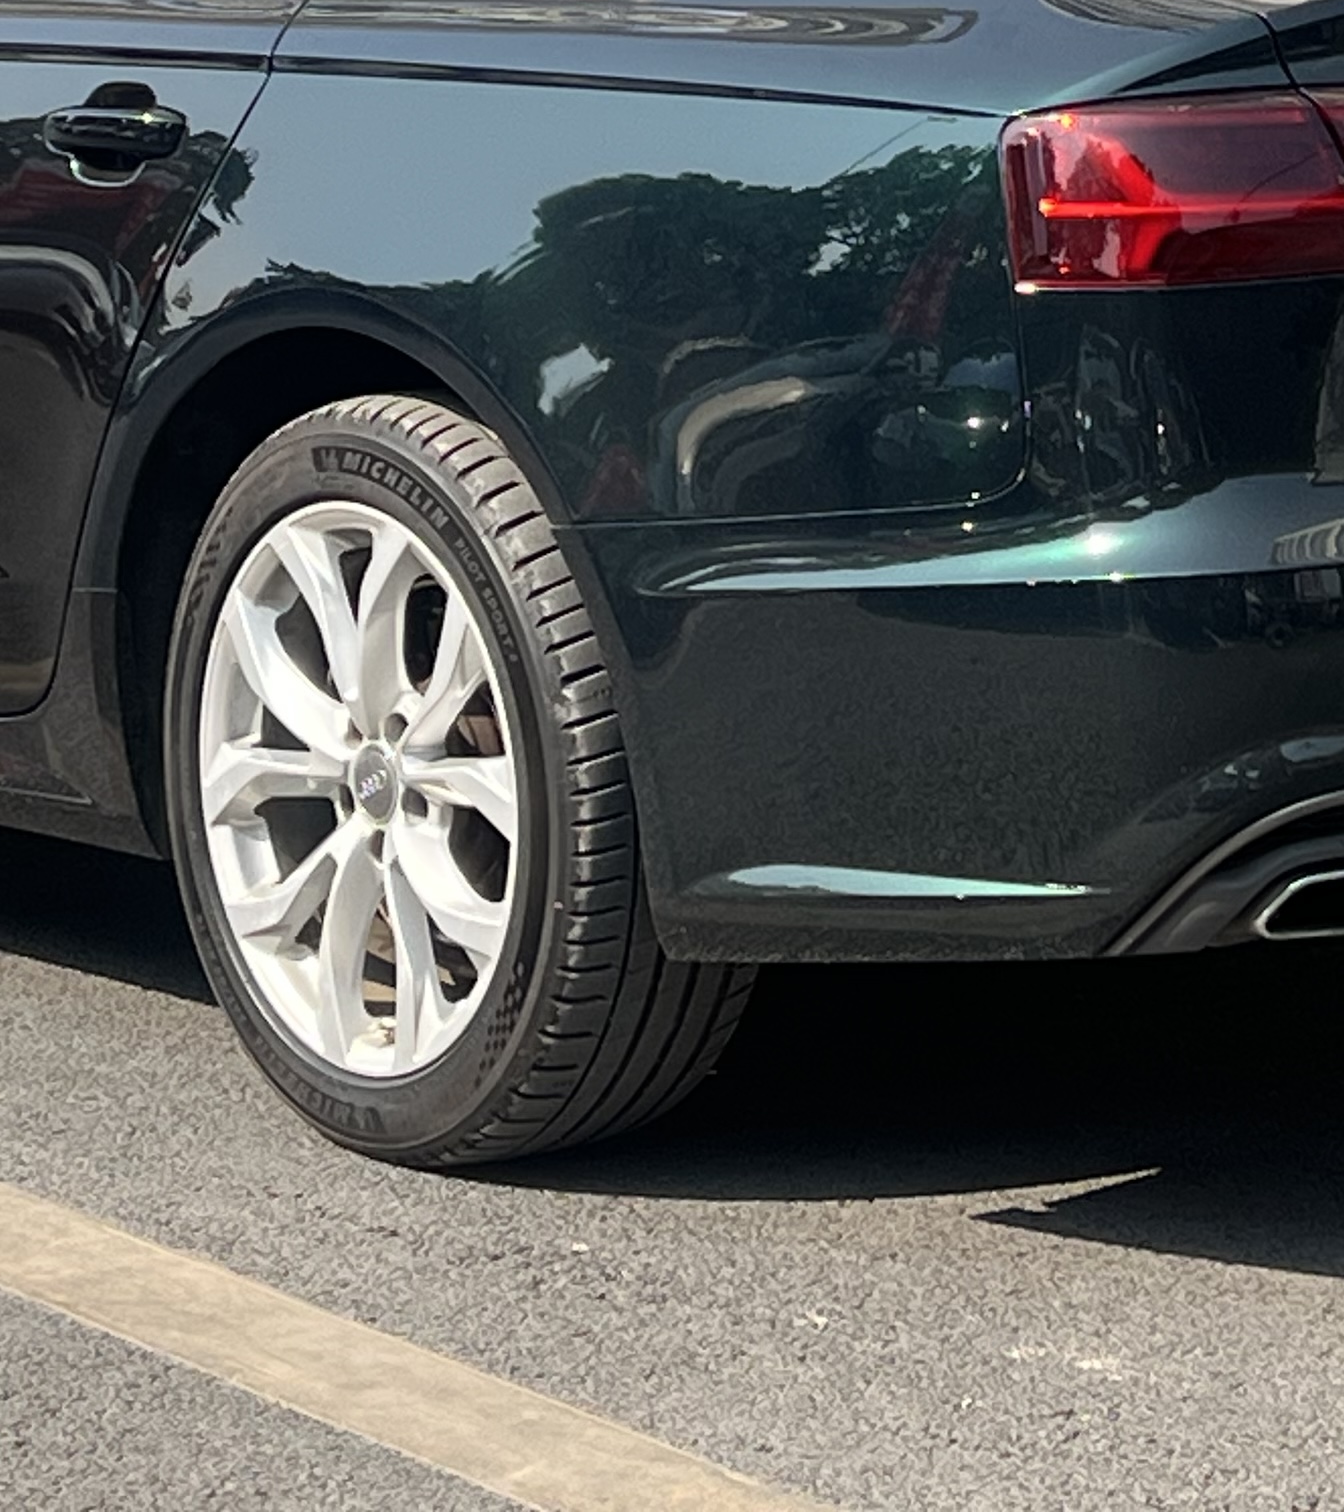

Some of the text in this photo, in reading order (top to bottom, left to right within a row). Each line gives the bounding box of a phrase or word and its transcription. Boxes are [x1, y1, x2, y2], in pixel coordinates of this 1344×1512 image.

[341, 450, 451, 531] MICHELIN
[452, 537, 487, 584] PILOT
[482, 587, 514, 649] SPORT
